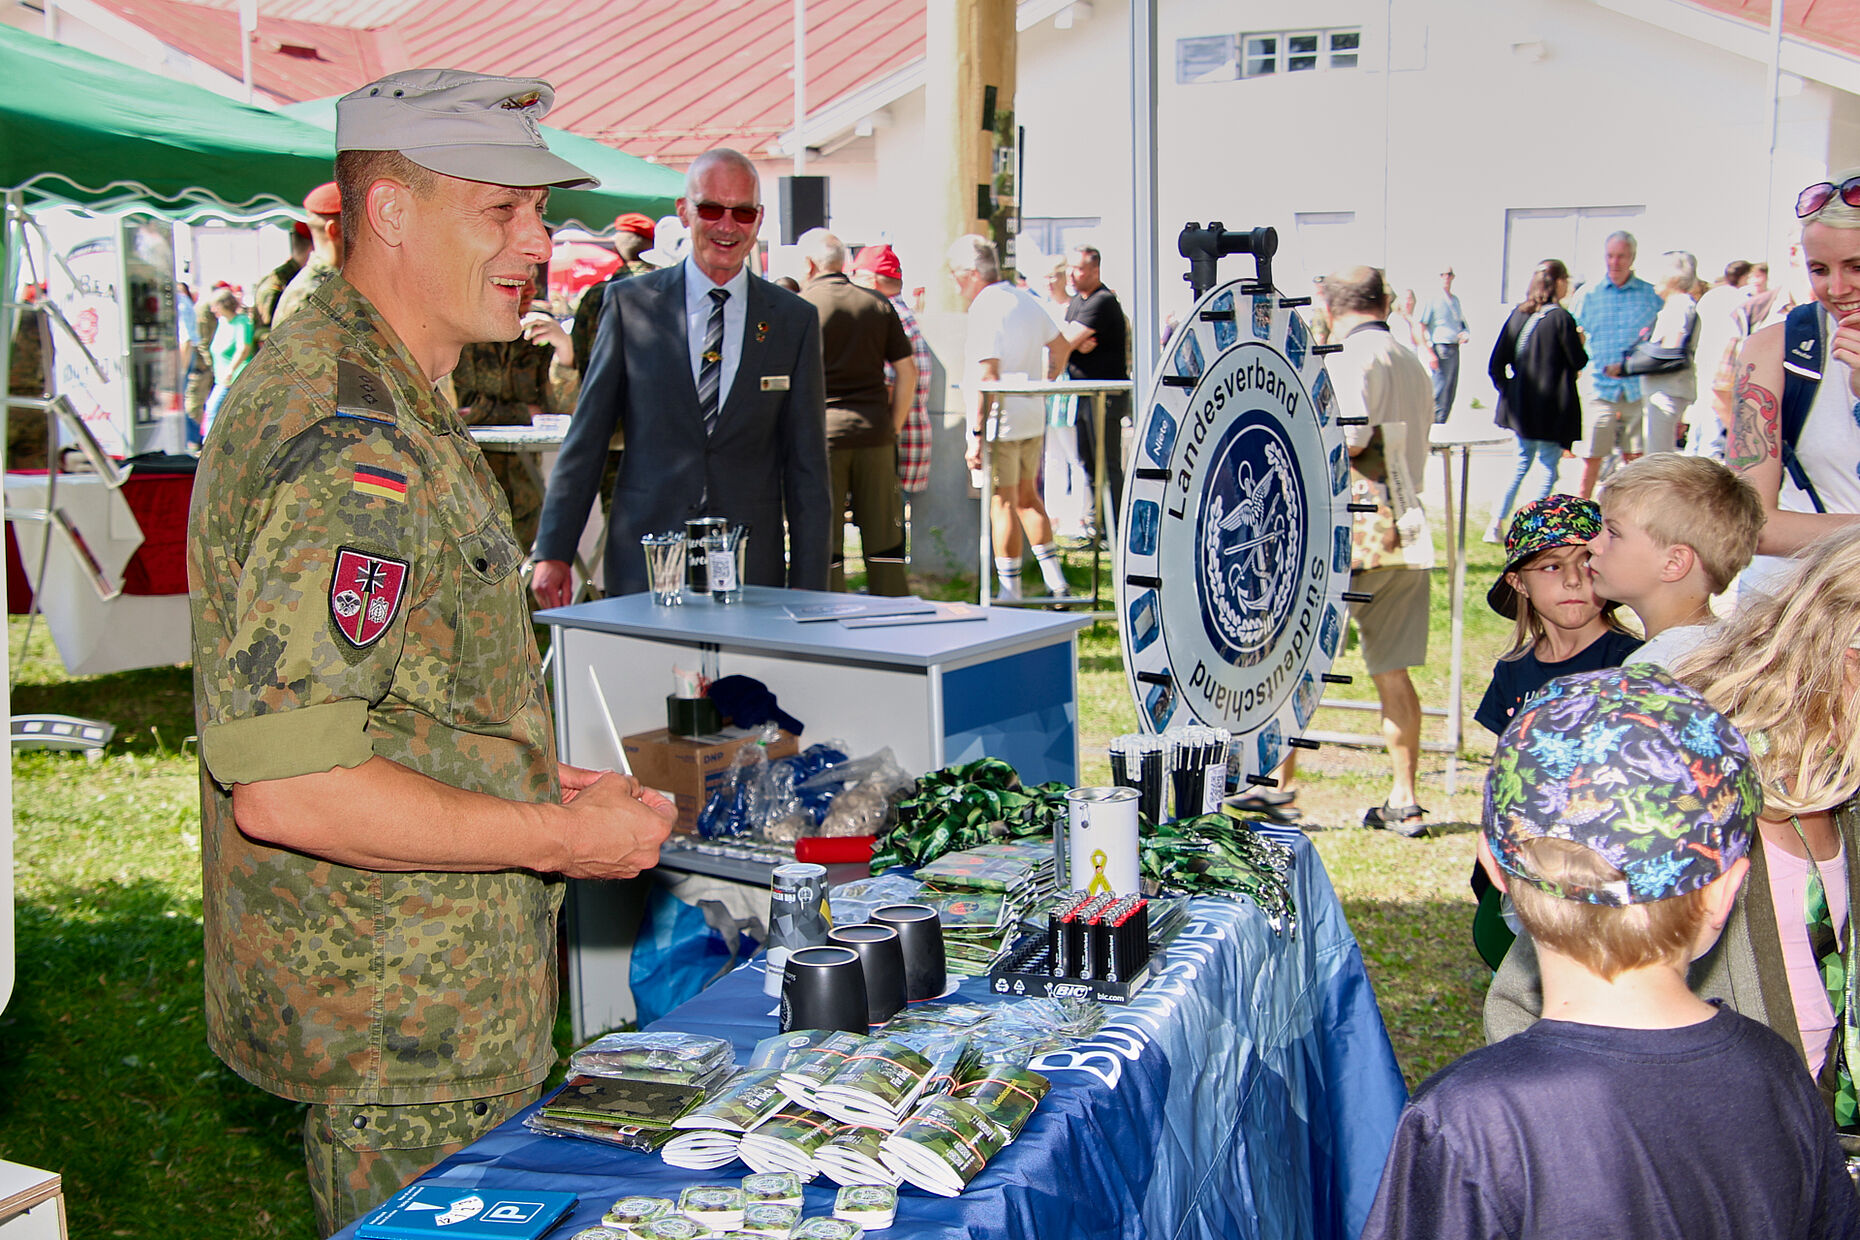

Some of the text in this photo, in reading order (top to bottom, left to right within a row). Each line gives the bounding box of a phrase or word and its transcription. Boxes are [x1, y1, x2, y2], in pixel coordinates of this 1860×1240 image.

[1153, 419, 1168, 457] Niete
[1168, 357, 1299, 521] Landesverband
[1189, 555, 1325, 721] Süddeutschland
[703, 752, 724, 764] DNP
[1056, 986, 1086, 997] BIC
[1097, 992, 1125, 1002] bic.com
[489, 1206, 528, 1220] P
